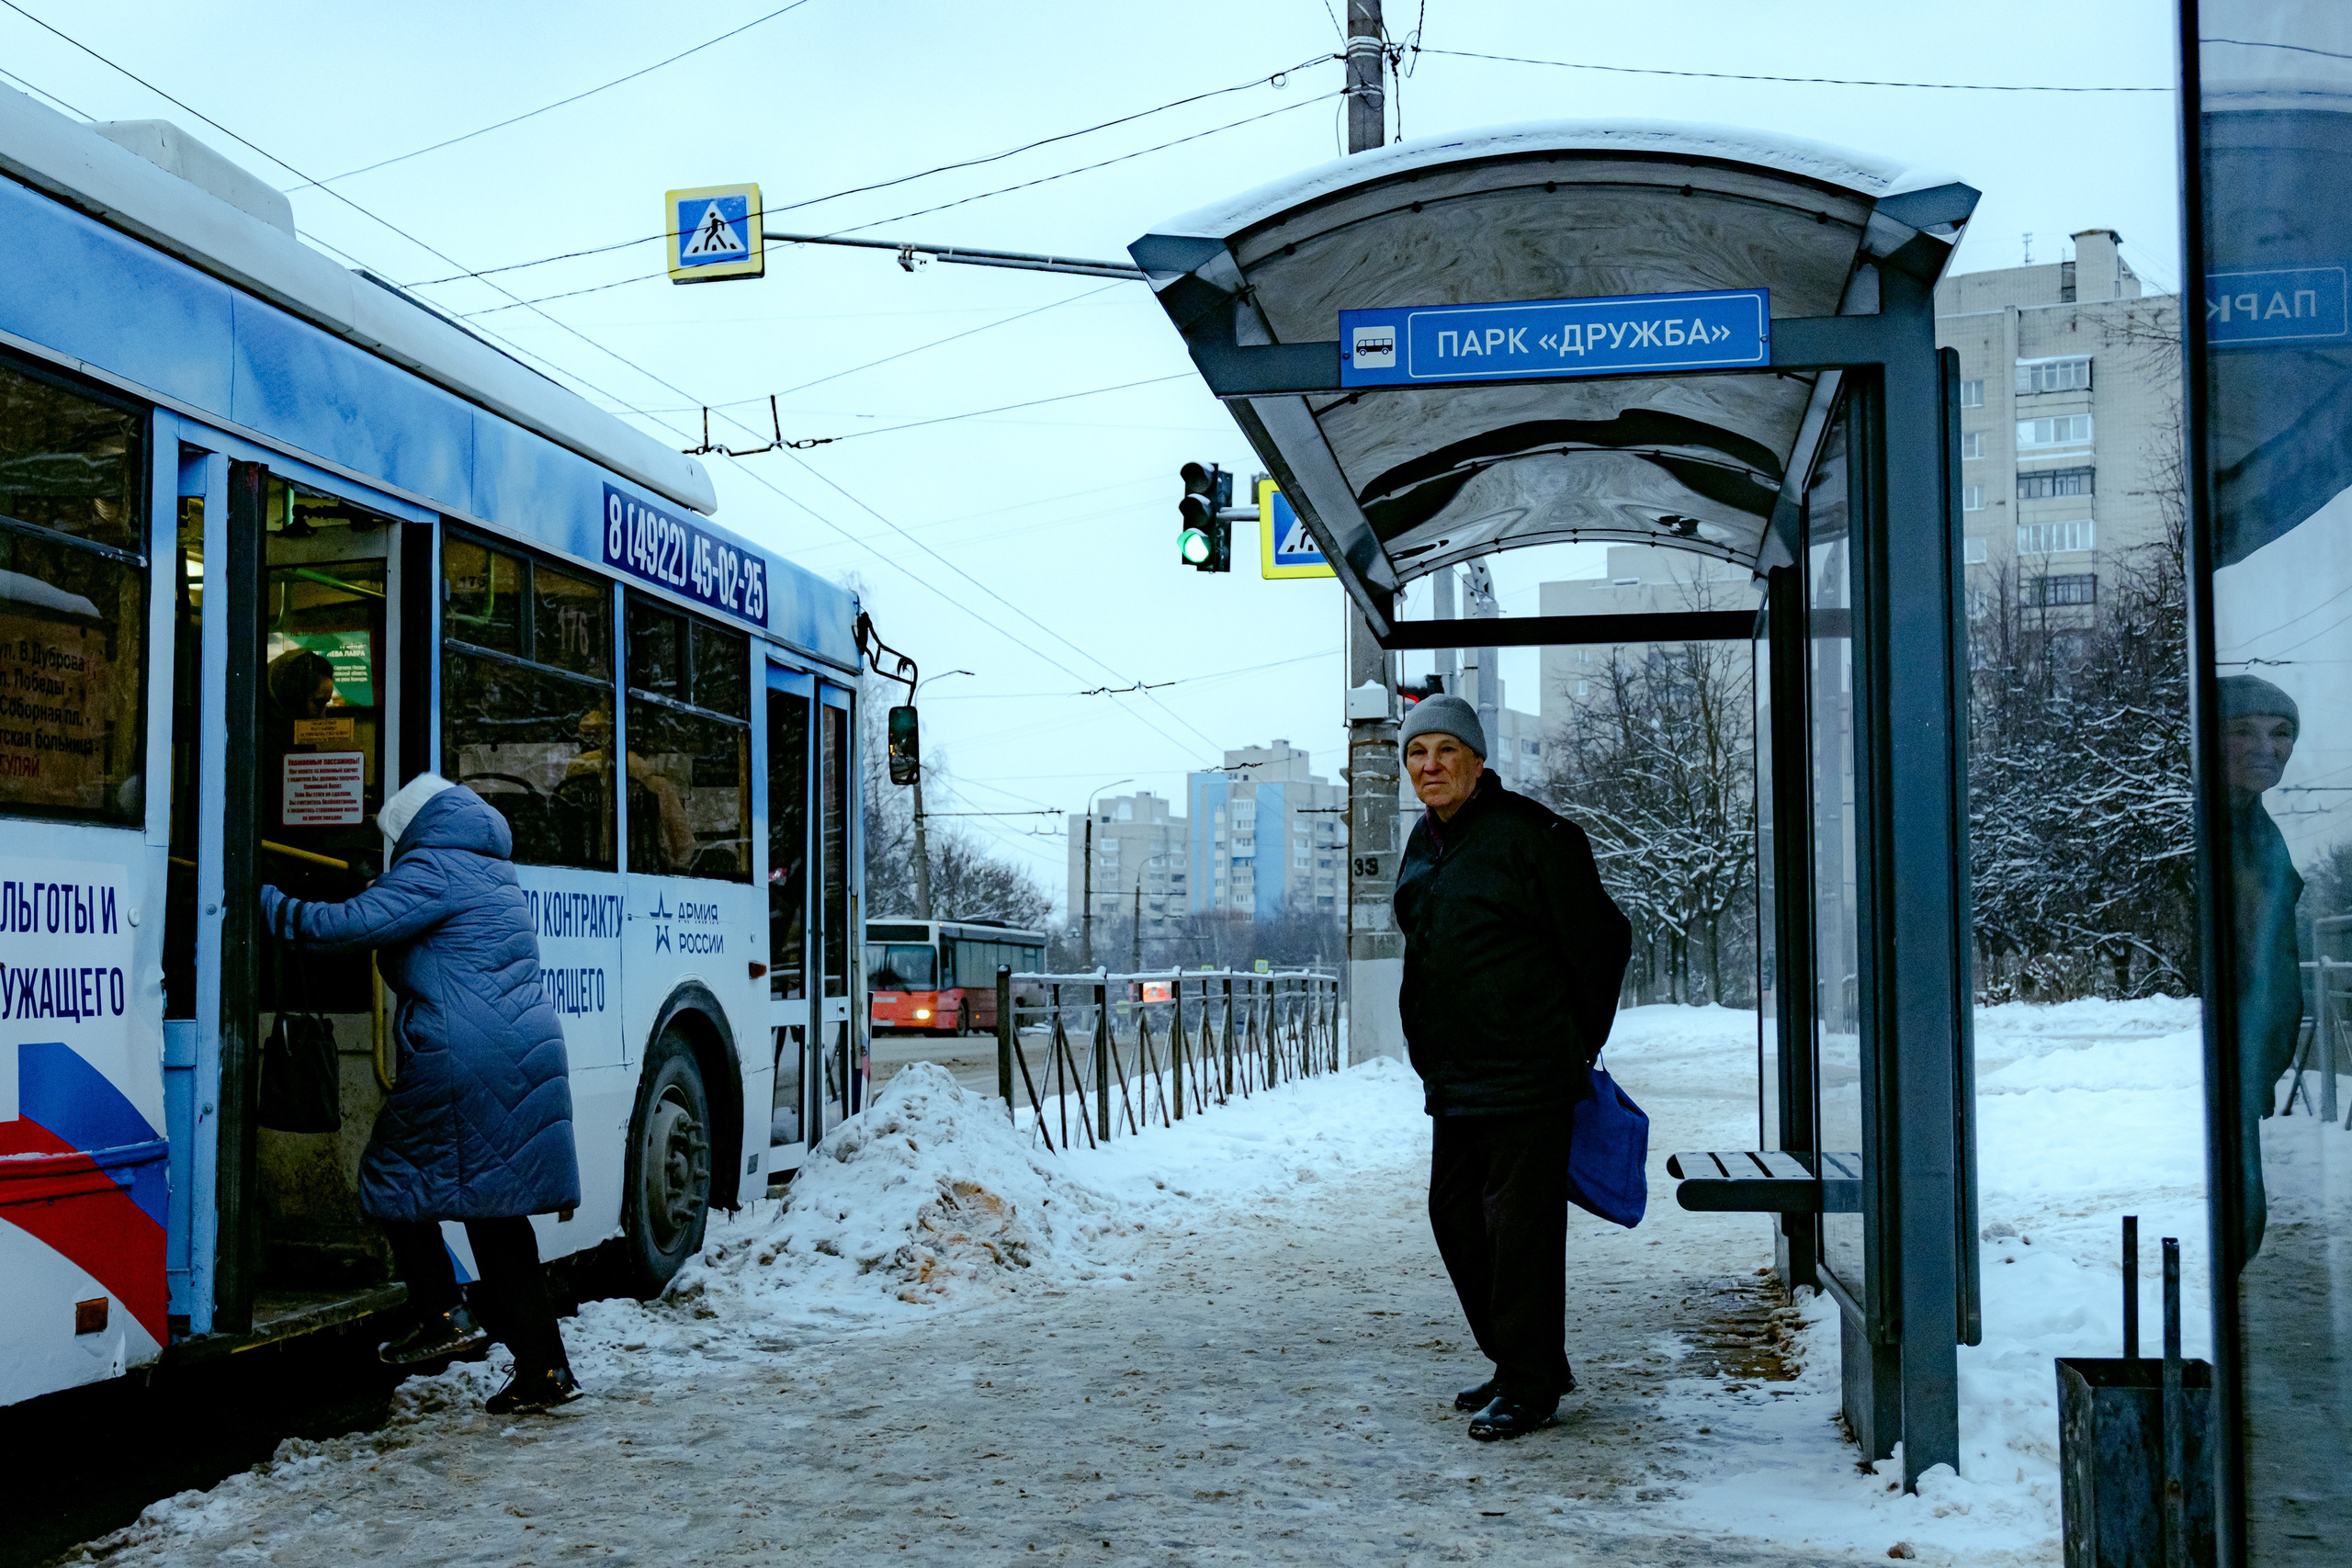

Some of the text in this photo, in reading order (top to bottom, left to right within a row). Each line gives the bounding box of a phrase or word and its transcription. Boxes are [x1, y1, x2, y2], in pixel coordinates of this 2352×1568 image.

[1438, 318, 1731, 357] ПАРК «ДРУЖБА»
[609, 493, 763, 620] 8 (4922) 45-02-25
[15, 668, 64, 696] Победы
[0, 694, 62, 725] Соборная
[0, 881, 118, 934] ЛЬГОТЫ И
[544, 891, 624, 938] КОНТРАКТУ
[678, 902, 718, 924] АРМИЯ
[679, 932, 724, 954] РОССИИ
[0, 967, 124, 1023] УЖАЩЕГО
